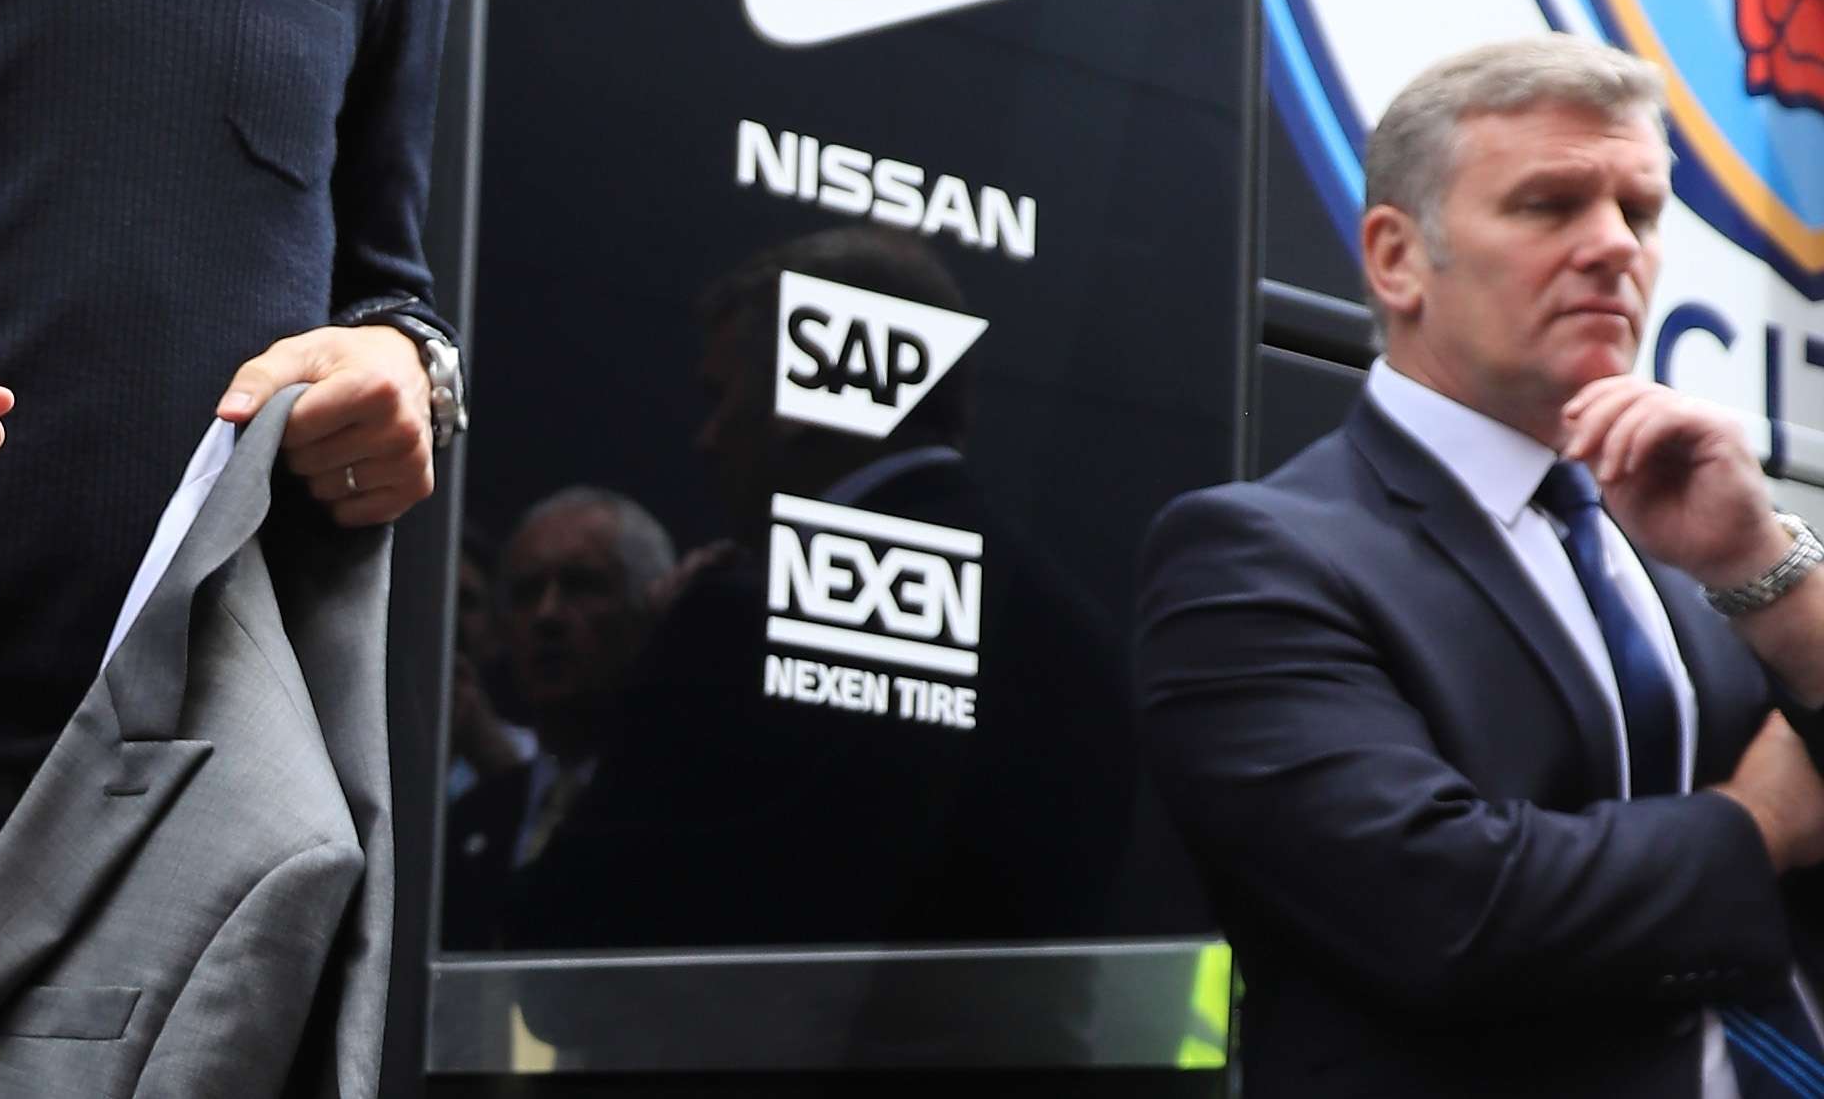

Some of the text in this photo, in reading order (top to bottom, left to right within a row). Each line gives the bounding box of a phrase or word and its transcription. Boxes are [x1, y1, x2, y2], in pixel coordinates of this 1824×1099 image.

[736, 118, 1038, 260] NISSAN
[787, 305, 931, 408] SAP
[1655, 302, 1824, 479] CI
[767, 522, 983, 647] NEXEN
[764, 654, 977, 730] NEXEN TIRE
